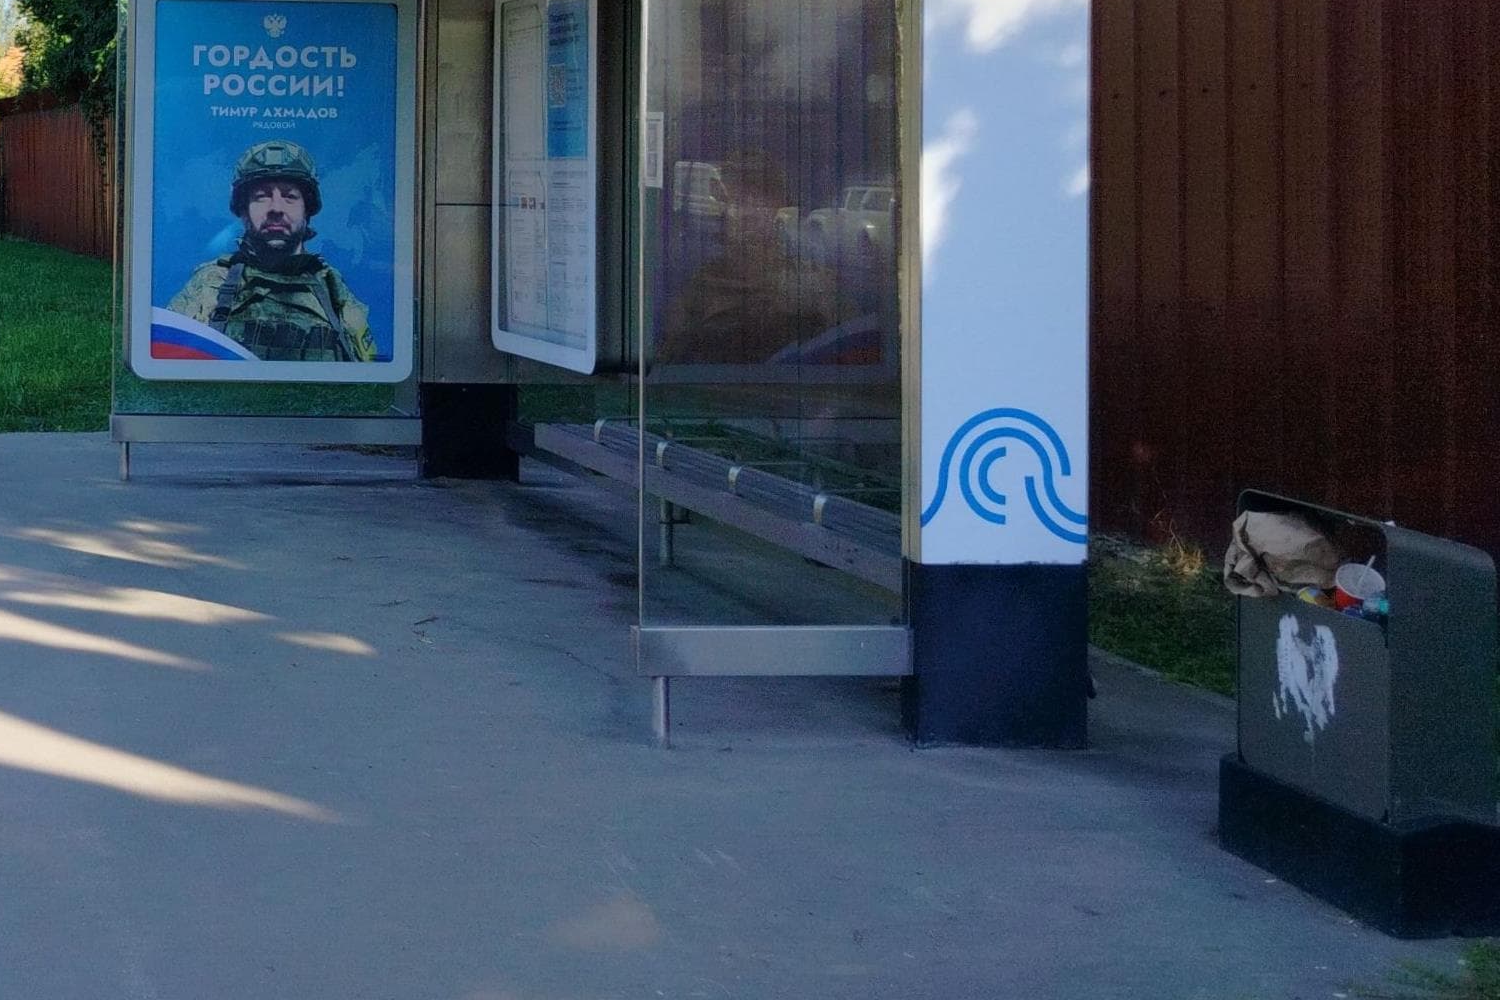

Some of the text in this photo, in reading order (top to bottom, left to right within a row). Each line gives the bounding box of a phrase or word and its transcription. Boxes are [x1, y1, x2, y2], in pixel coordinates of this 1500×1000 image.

[192, 44, 357, 70] ГОРДОСТЬ
[203, 73, 345, 98] РОССИИ!
[210, 105, 339, 120] ТИМУР АХМАДОВ
[252, 119, 296, 130] РЯДОВОЙ
